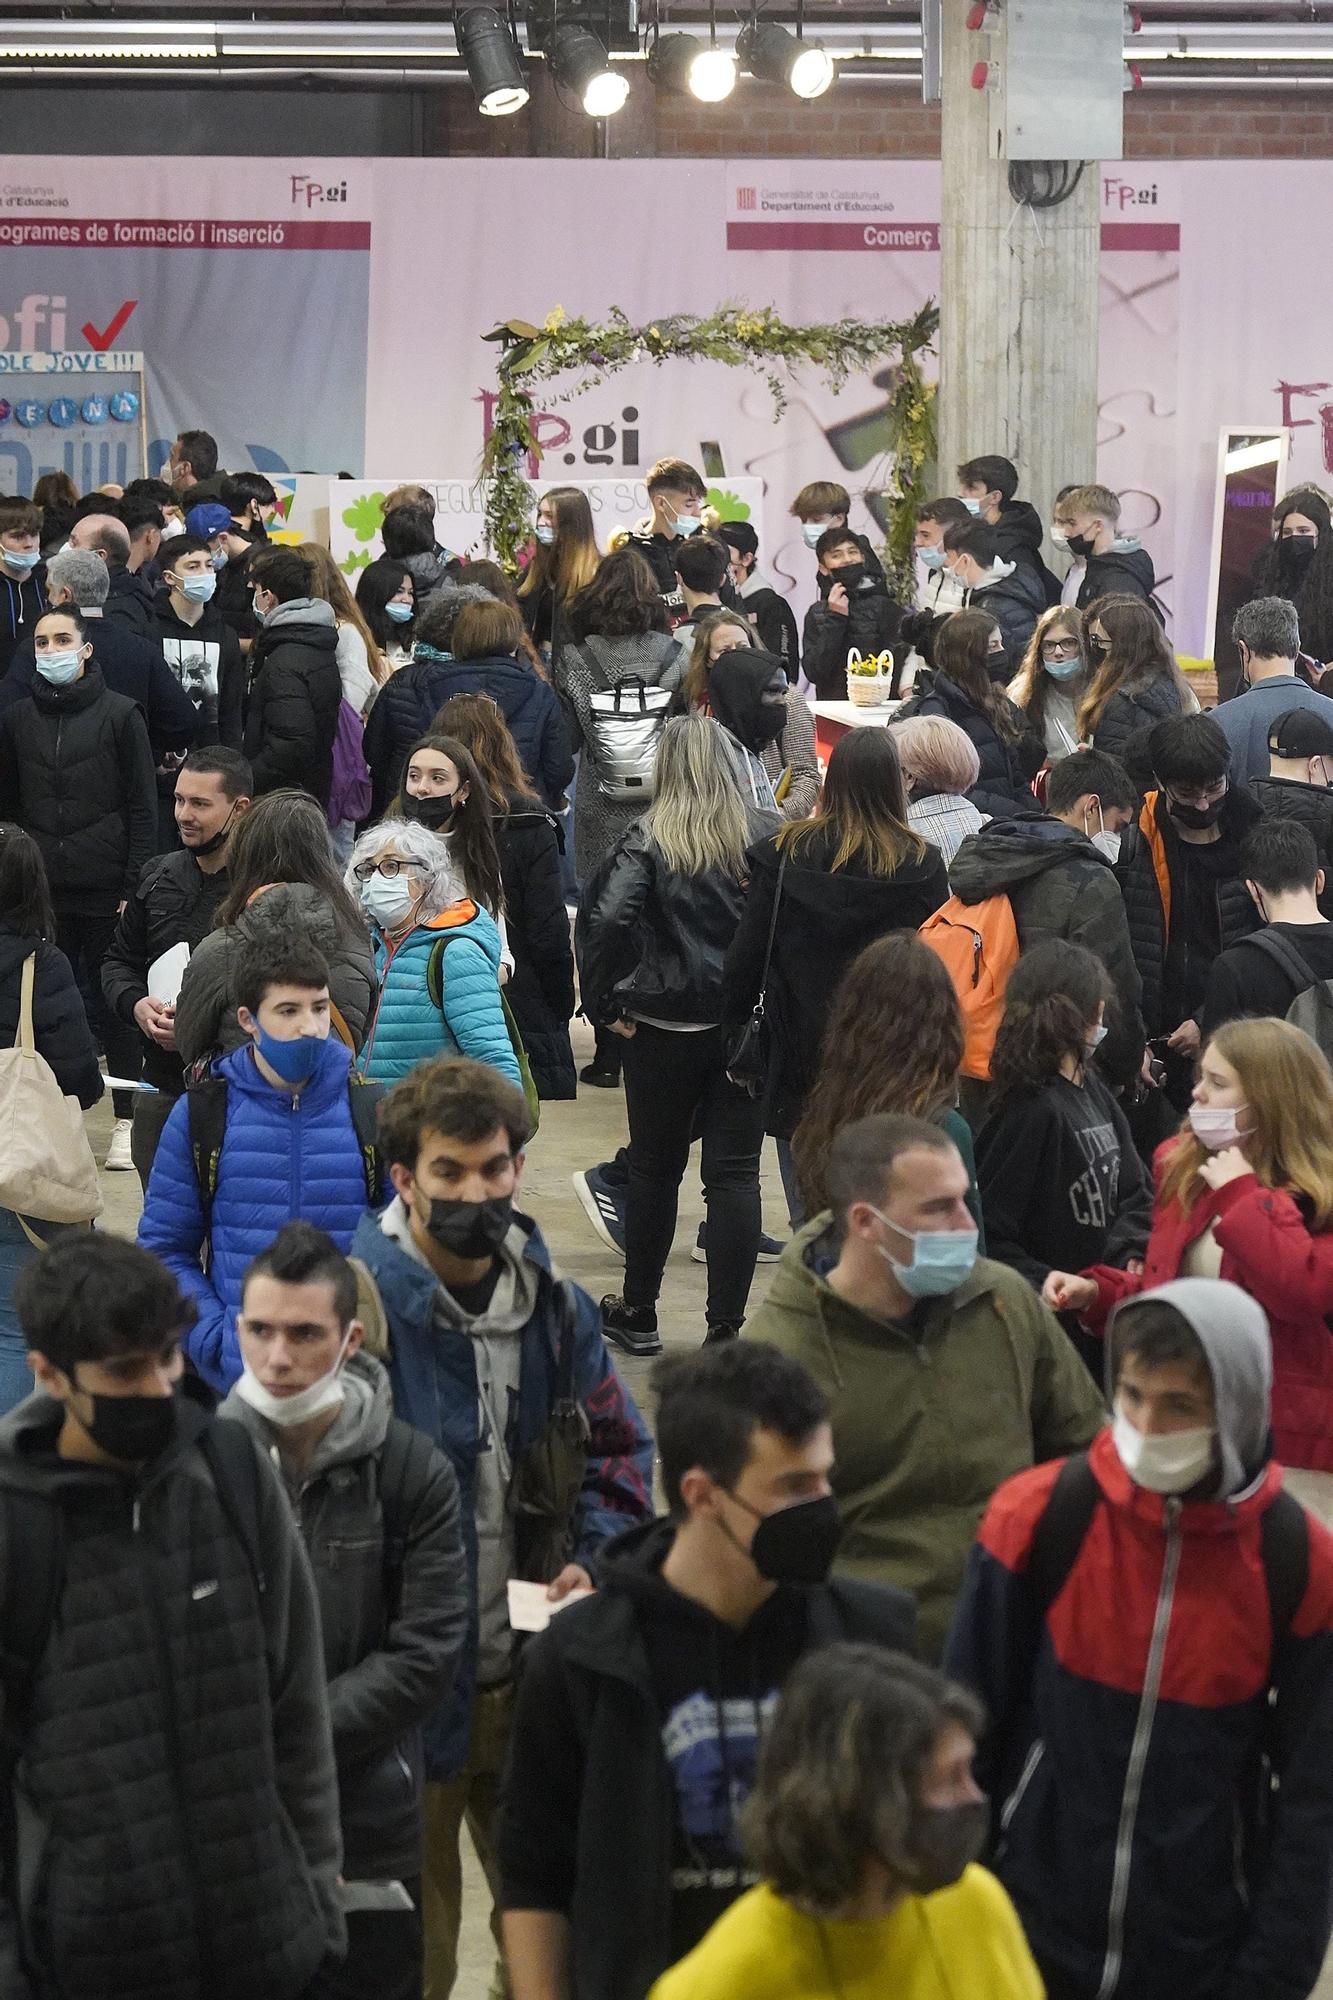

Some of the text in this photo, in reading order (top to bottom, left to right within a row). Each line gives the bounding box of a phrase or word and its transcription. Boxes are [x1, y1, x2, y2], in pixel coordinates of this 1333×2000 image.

[760, 200, 895, 212] Departament d'Educació
[0, 222, 285, 246] ogrames de formació i inserció
[863, 225, 932, 250] Comerç
[0, 294, 67, 351] fi
